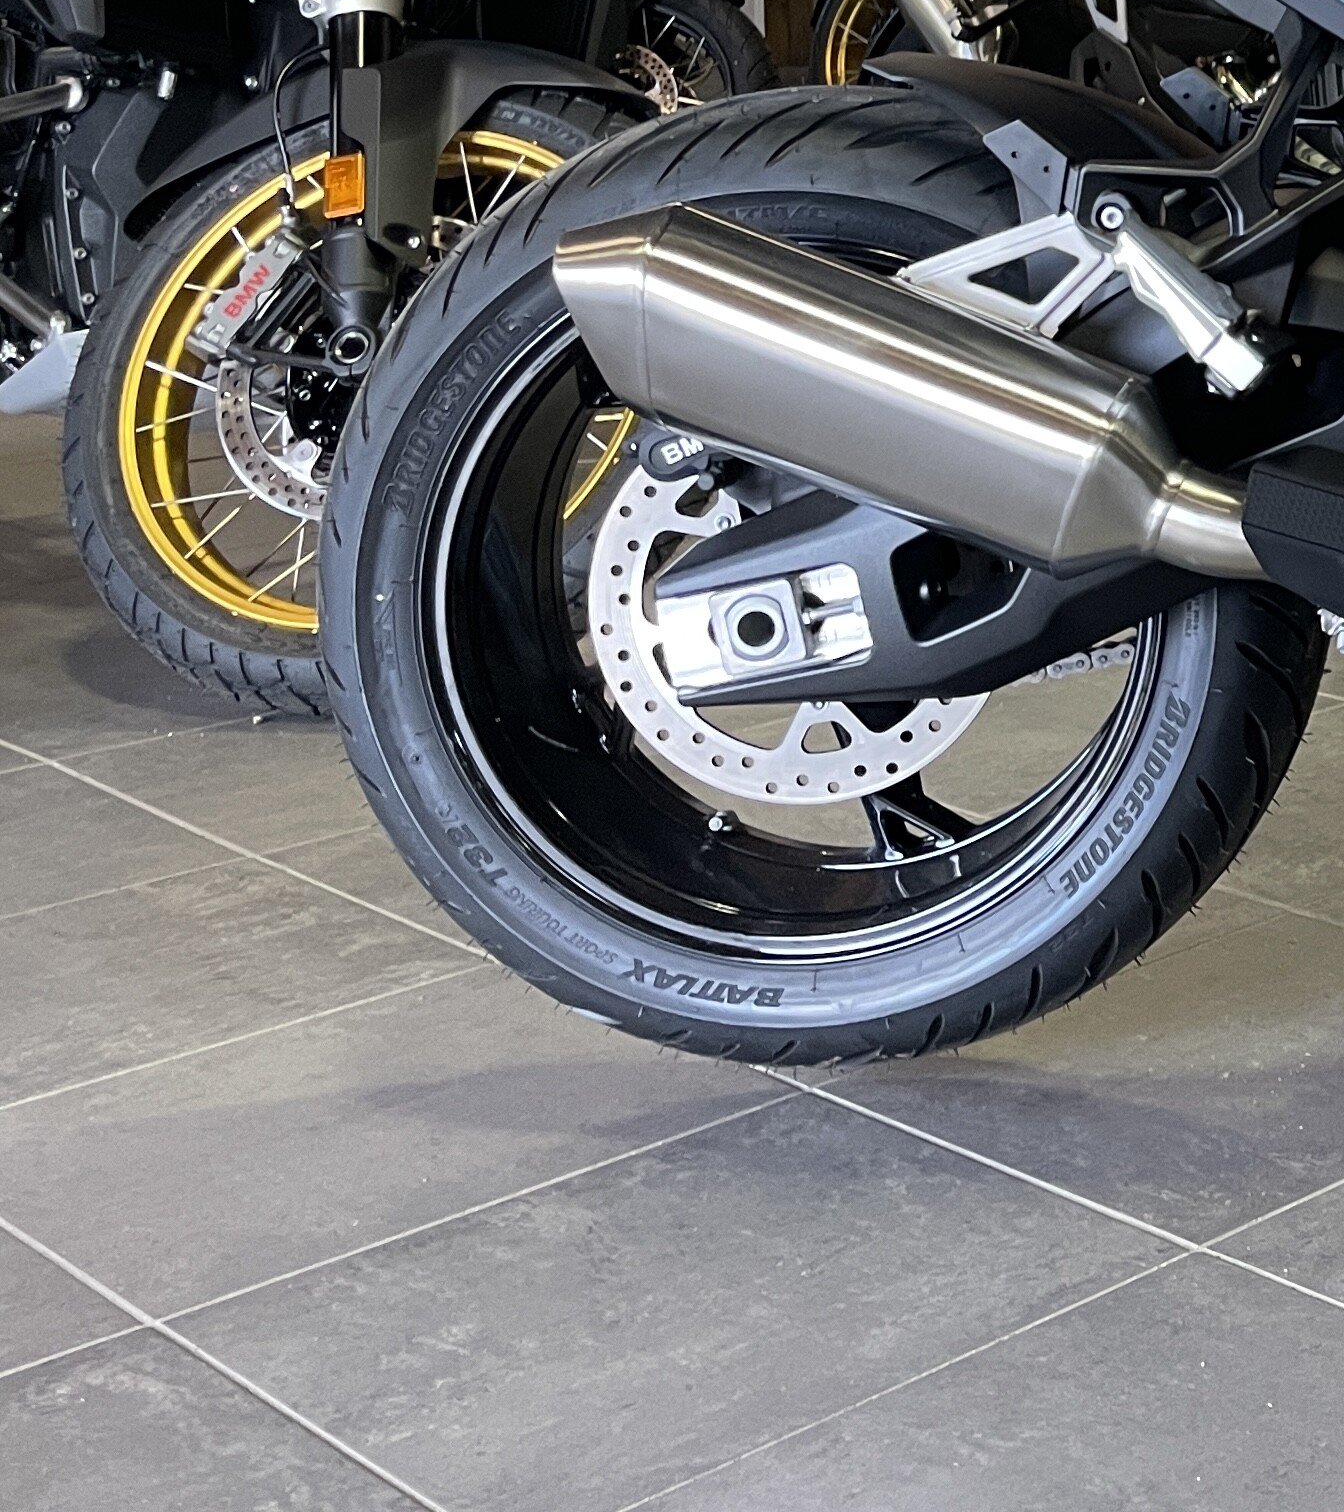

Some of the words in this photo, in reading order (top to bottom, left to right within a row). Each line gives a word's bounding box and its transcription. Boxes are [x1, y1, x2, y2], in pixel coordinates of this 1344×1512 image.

[224, 264, 270, 318] BMW
[382, 308, 521, 516] BRIDGESTONE
[661, 437, 704, 465] BM
[1059, 691, 1191, 899] BRIDGESTONE
[450, 823, 508, 889] T32
[506, 886, 569, 938] TOURING
[569, 930, 619, 965] SPORT
[617, 957, 785, 1008] BATTLAX
